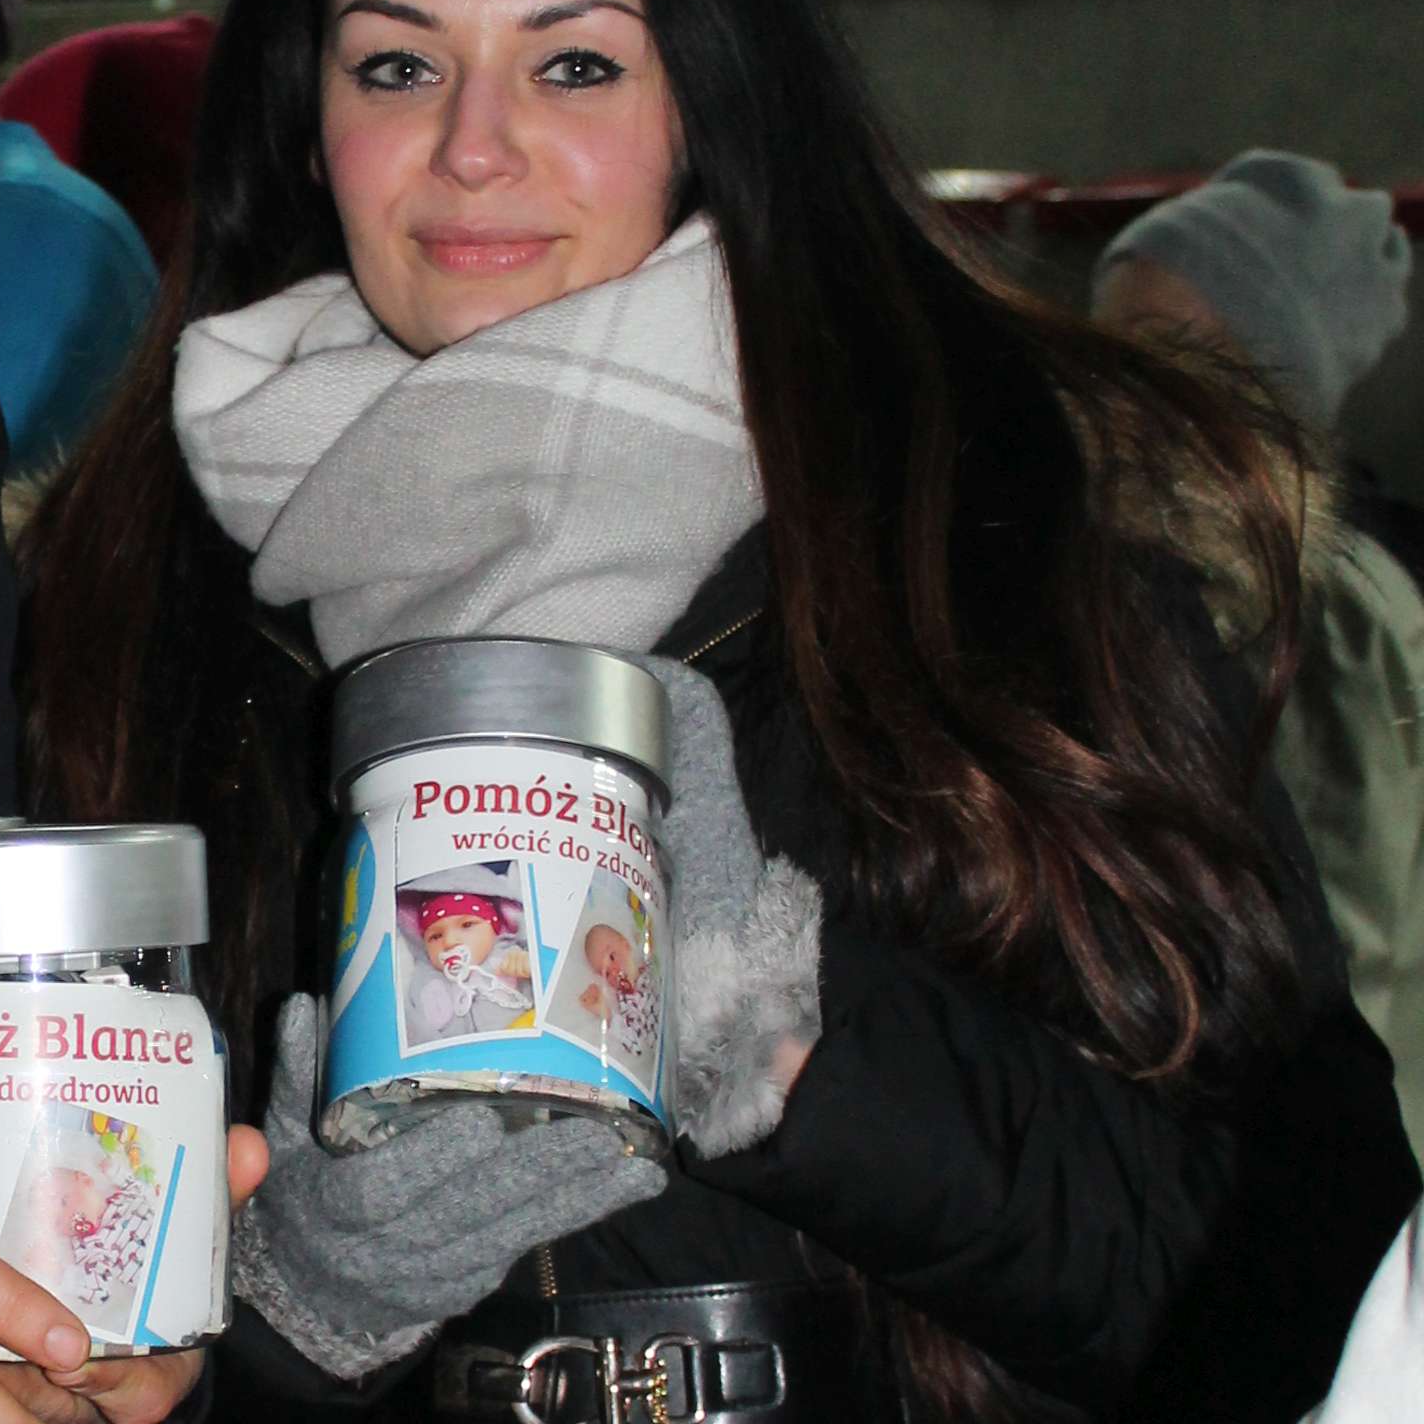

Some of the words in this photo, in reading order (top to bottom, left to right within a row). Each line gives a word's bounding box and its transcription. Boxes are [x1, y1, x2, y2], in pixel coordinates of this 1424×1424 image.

[412, 774, 578, 824] Pomóż
[452, 825, 551, 854] wrócić
[559, 836, 590, 862] do
[35, 1013, 193, 1065] Blance
[42, 1076, 160, 1105] zdrowia
